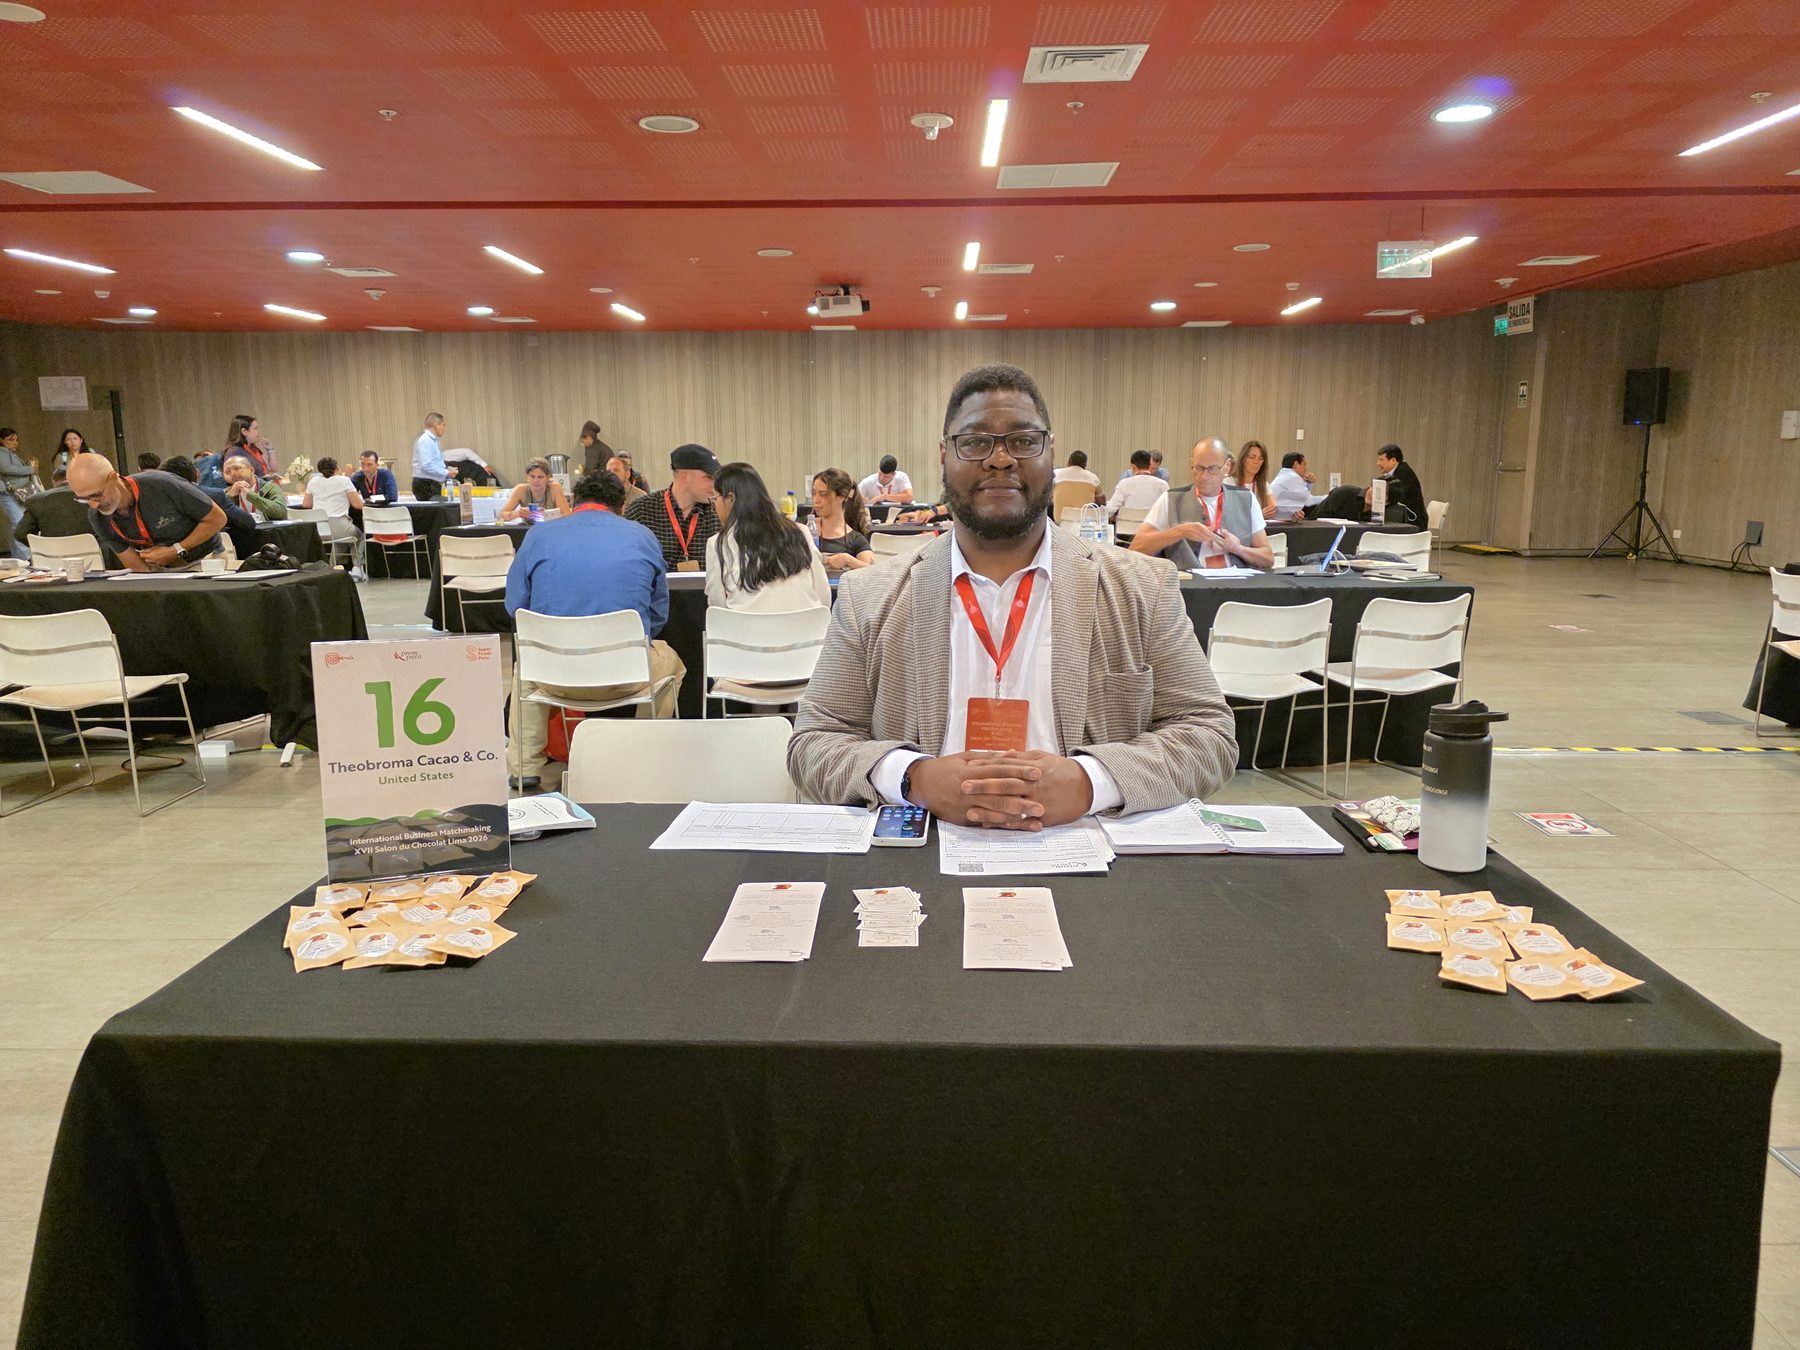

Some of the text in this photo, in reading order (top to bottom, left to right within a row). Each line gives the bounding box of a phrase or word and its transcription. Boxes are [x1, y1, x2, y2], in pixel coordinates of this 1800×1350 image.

[1509, 303, 1531, 319] SALIDA
[364, 677, 456, 748] 16
[328, 750, 498, 774] Theobroma Cacao & Co.
[378, 771, 454, 785] United States
[350, 824, 492, 846] International Business Matchmaking
[354, 833, 488, 856] XVII Salon du Chocolat Lima 2026
